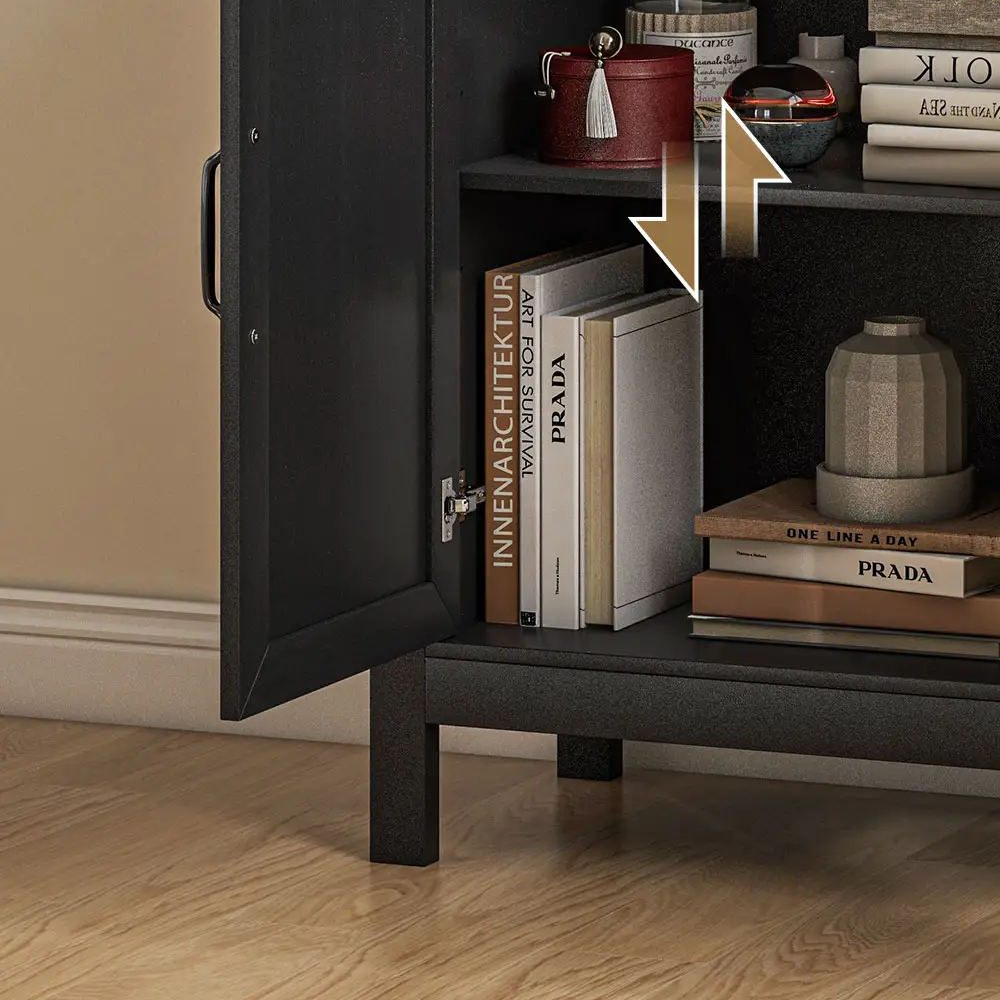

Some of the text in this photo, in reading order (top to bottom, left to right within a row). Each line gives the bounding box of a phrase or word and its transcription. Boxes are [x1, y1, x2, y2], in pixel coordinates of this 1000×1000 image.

[493, 274, 514, 567] INNENARCHITEKTUR
[521, 289, 534, 479] ART FOR SURVIVAL
[551, 353, 566, 444] PRADA
[786, 528, 918, 547] ONE LINE A DAY
[858, 560, 934, 583] PRADA
